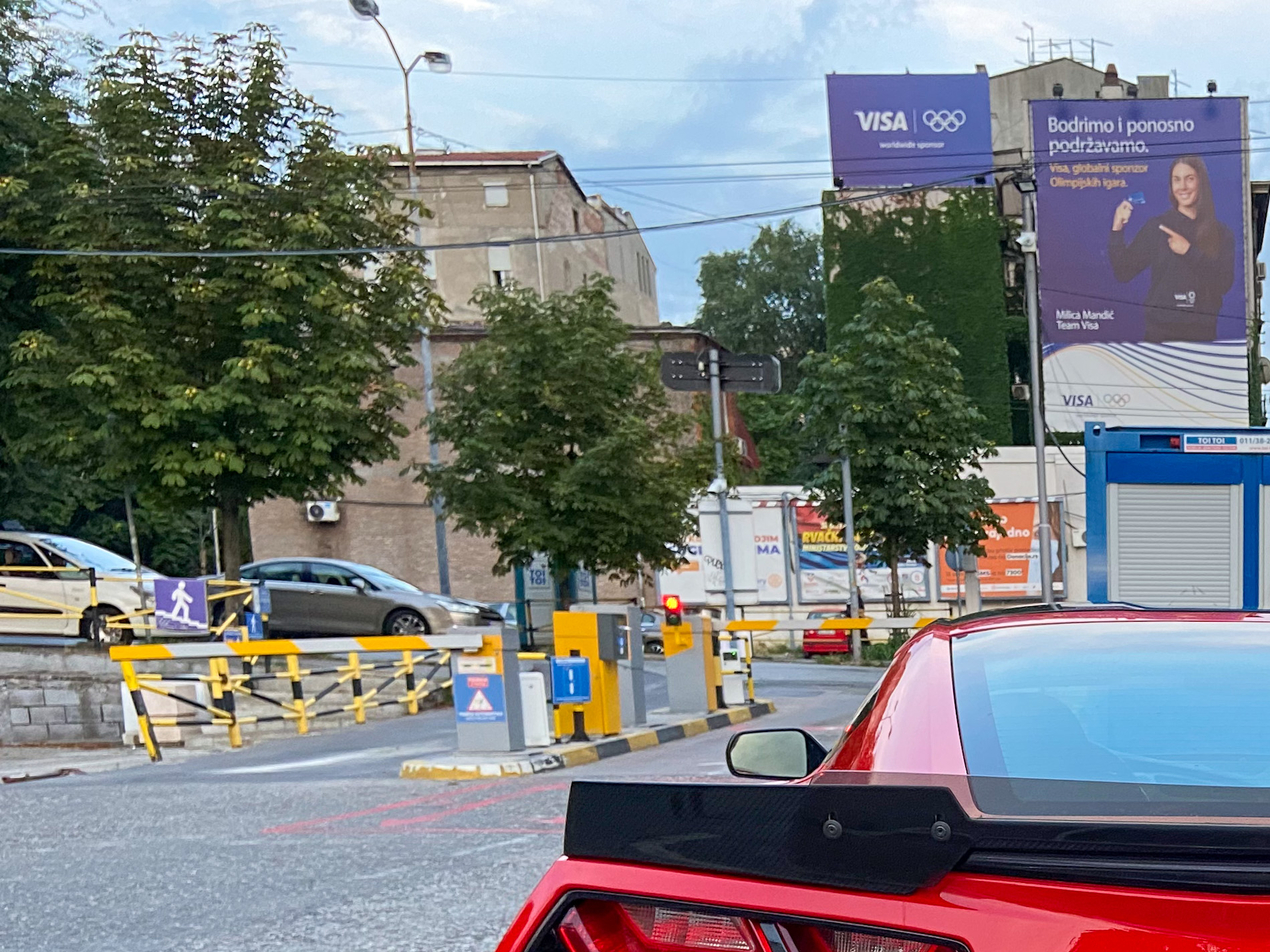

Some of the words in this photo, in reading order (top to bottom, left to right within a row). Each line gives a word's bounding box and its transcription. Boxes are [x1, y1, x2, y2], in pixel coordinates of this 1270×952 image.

[854, 110, 908, 131] VISA
[1048, 115, 1115, 133] Bodrimo
[1118, 116, 1122, 133] i
[1126, 119, 1195, 137] ponosno
[879, 141, 916, 149] worldwide
[1049, 136, 1150, 156] podržavamo.
[1072, 163, 1110, 175] globalni
[1056, 309, 1081, 320] Milica
[1082, 309, 1115, 320] Mandić
[1056, 321, 1080, 330] Team
[1081, 321, 1099, 330] Visa
[1062, 395, 1093, 407] VISA
